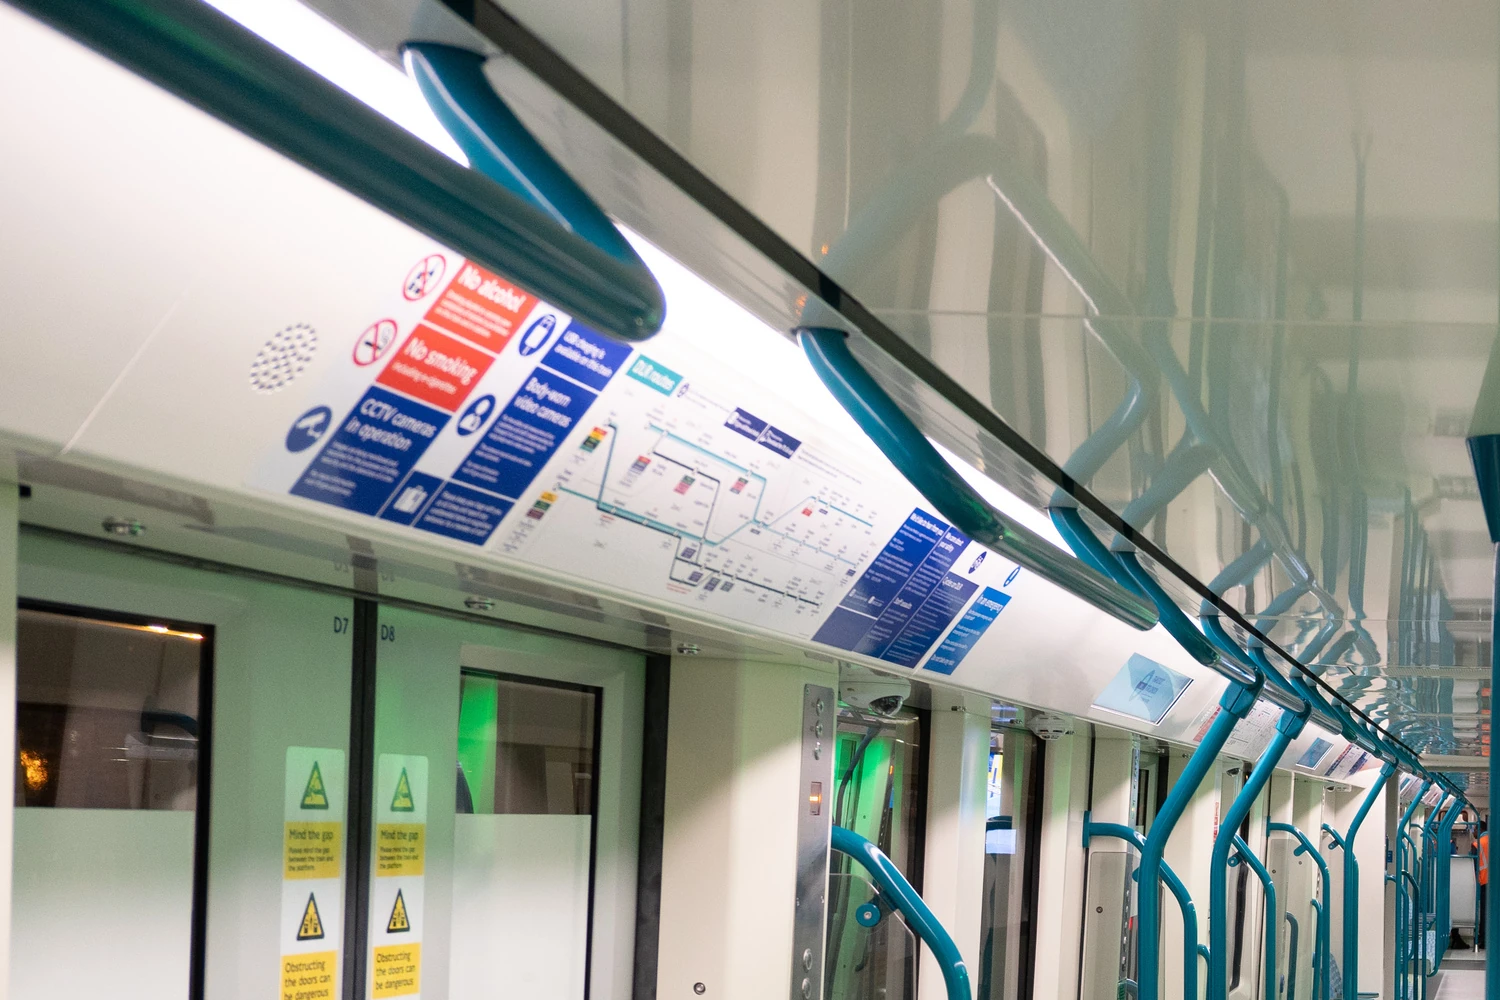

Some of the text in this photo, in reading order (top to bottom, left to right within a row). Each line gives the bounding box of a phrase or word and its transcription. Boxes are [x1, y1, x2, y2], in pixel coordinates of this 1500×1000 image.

[458, 265, 481, 290] No
[477, 279, 526, 313] alcohol
[404, 337, 478, 386] No smoking
[632, 359, 675, 391] DLR routes
[525, 376, 572, 408] Body-worn
[360, 398, 437, 438] CCTV cameras
[514, 395, 572, 428] video cameras
[345, 415, 412, 452] in operation
[334, 616, 348, 634] D7
[381, 624, 395, 641] D8
[289, 829, 334, 842] Mind the gap
[381, 830, 419, 842] Mind the gap
[285, 960, 325, 972] Obstructing
[376, 952, 411, 963] Obstructing
[376, 965, 415, 976] the doors can
[285, 975, 331, 987] the doors can
[376, 978, 413, 990] be dangerous
[295, 989, 329, 1000] dangerous
